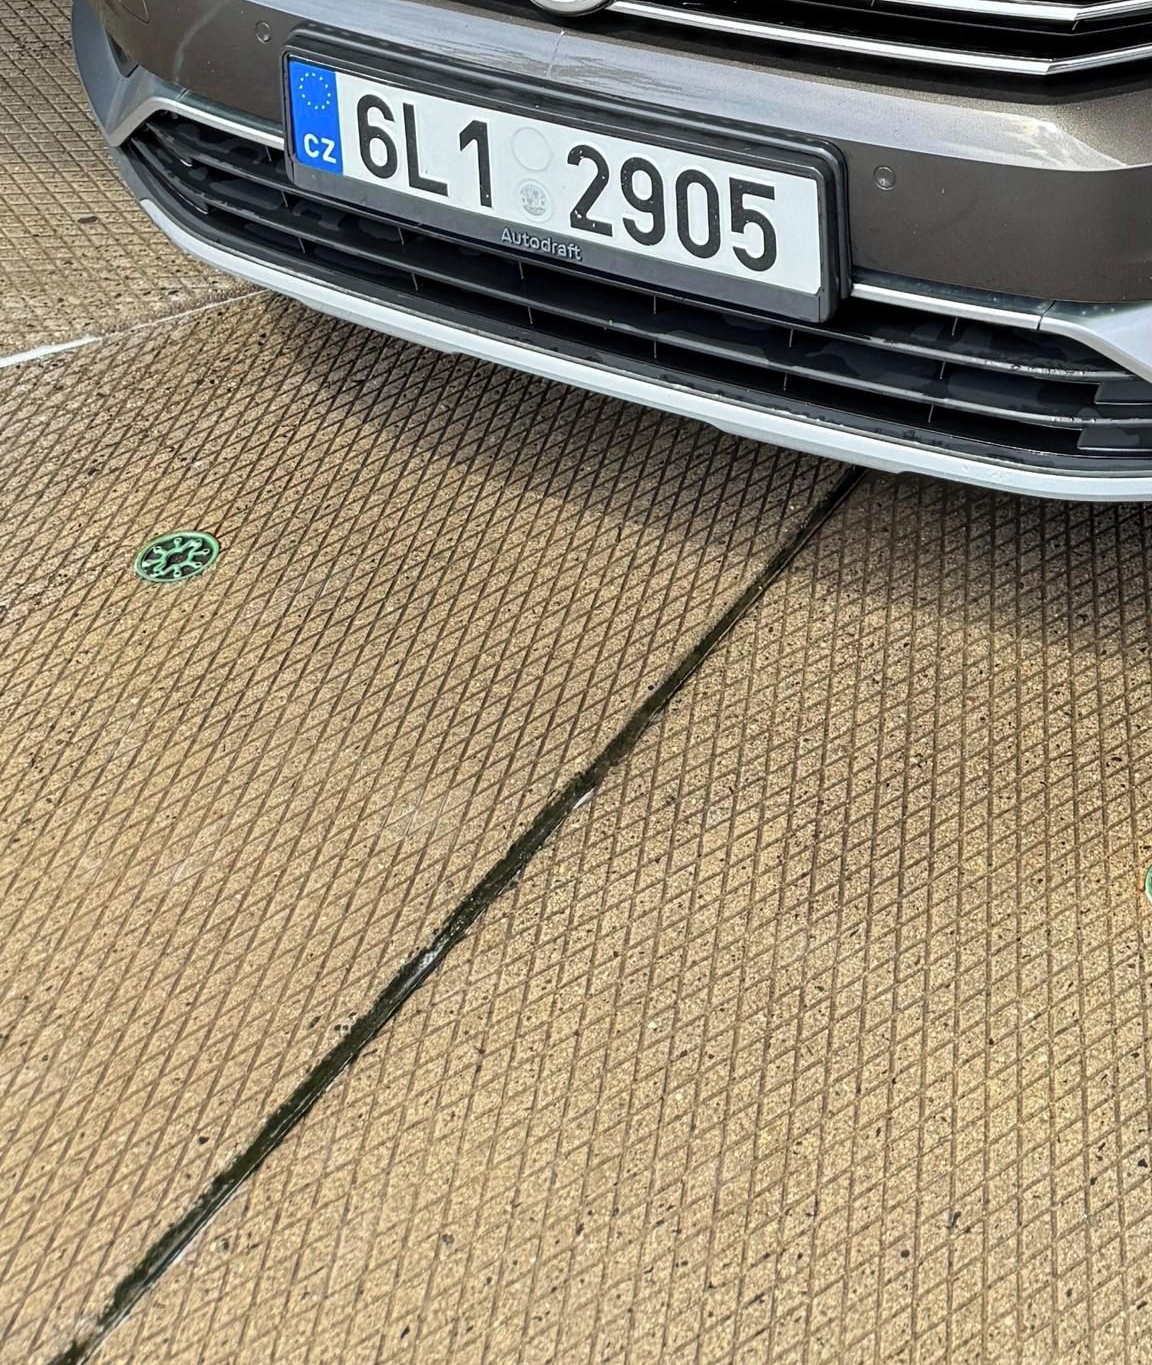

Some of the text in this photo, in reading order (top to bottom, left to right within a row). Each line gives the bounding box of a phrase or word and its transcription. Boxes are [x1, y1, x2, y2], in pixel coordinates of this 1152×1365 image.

[304, 132, 337, 165] CZ
[357, 92, 777, 273] 6L1 2905
[501, 227, 582, 262] Autodraft
